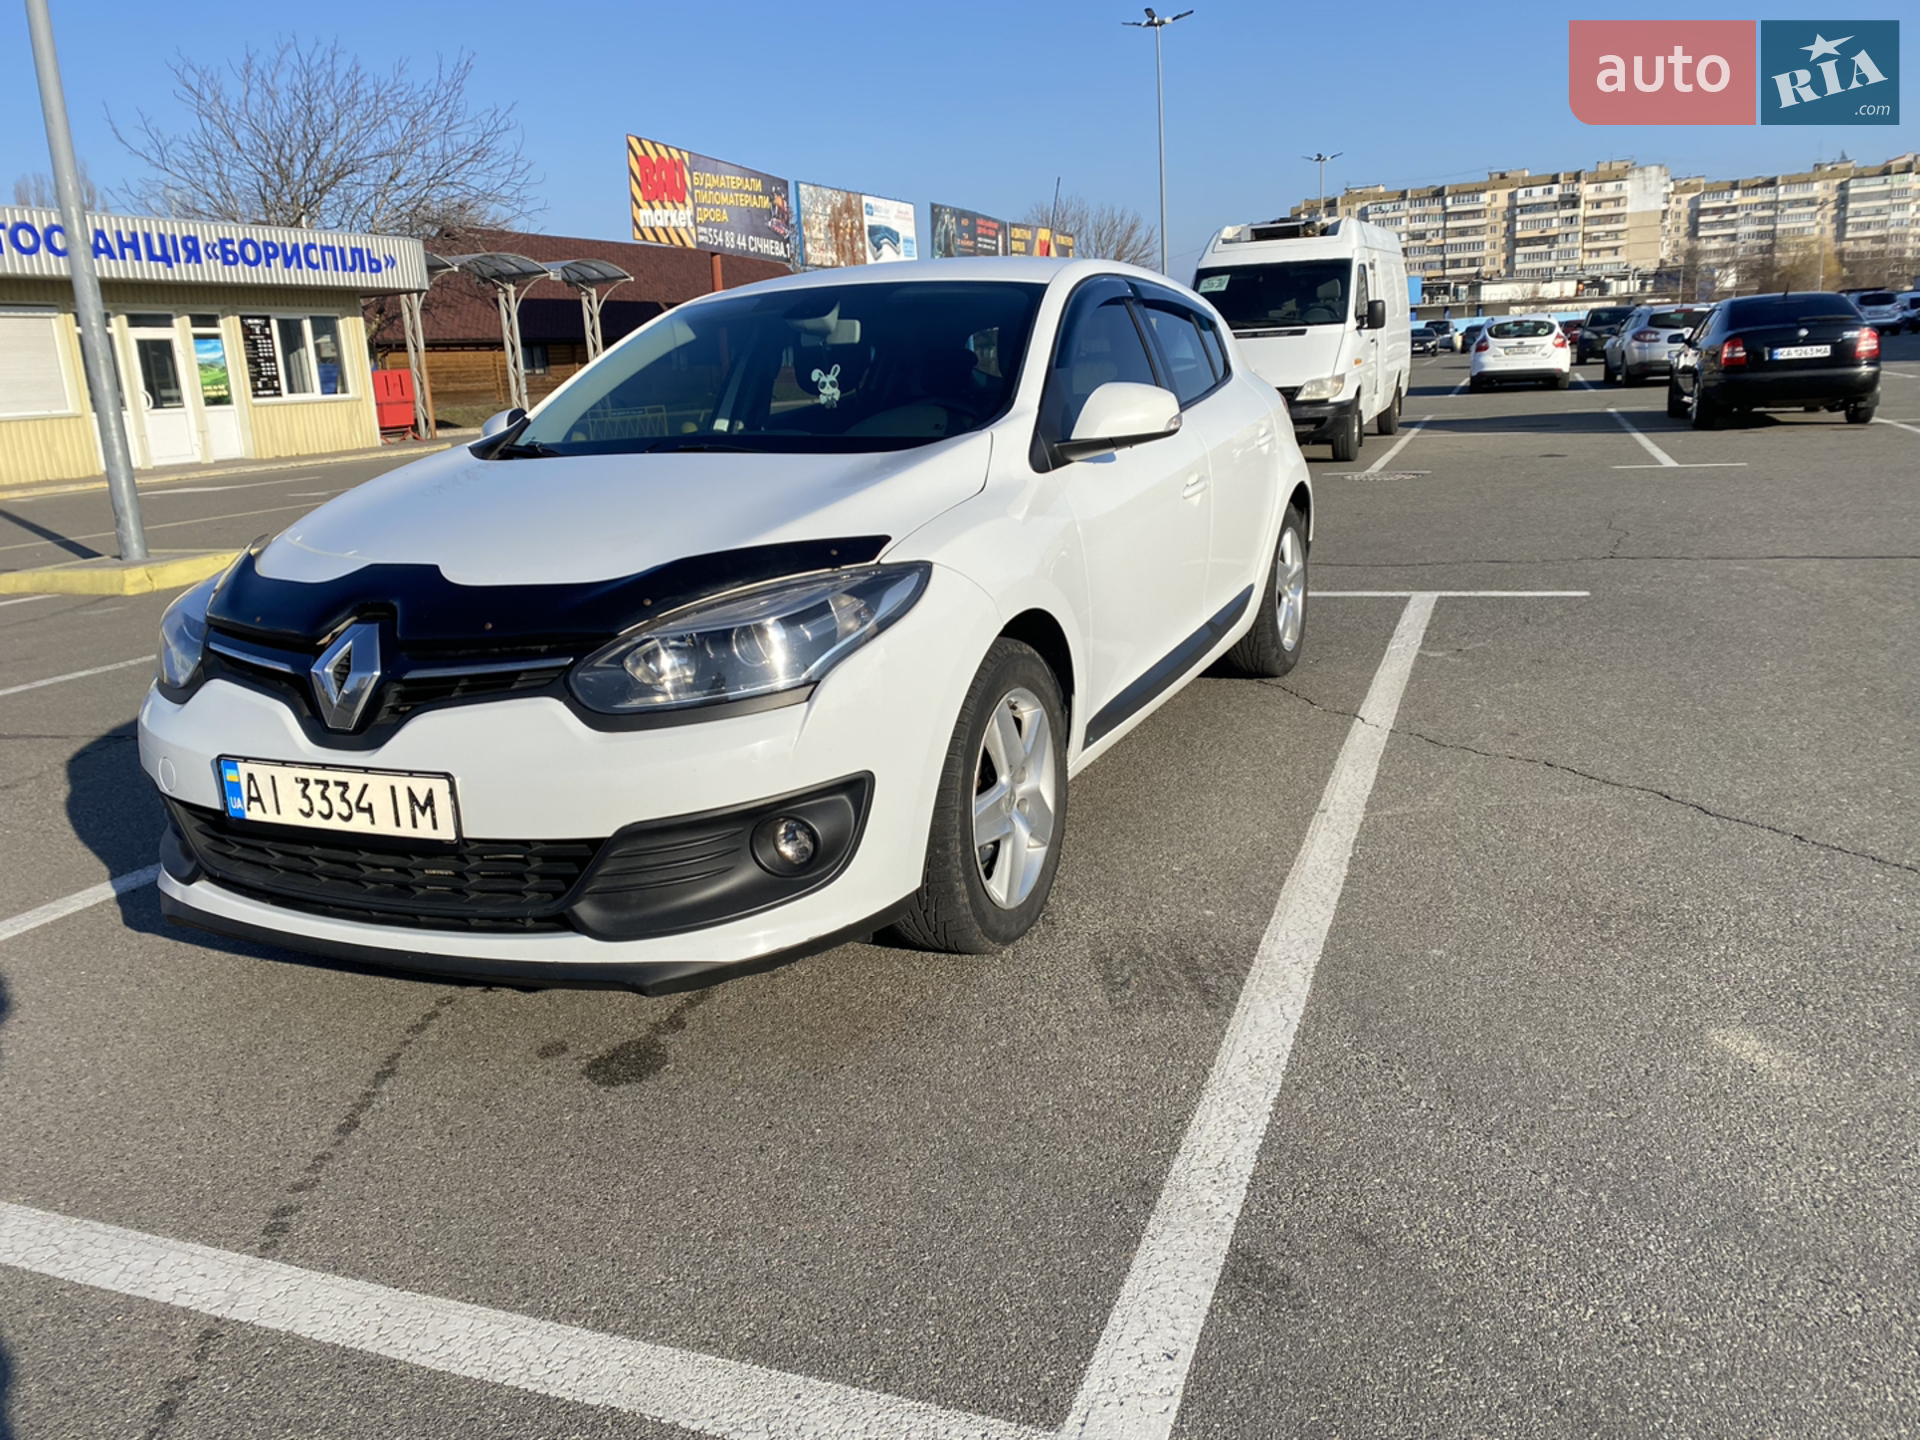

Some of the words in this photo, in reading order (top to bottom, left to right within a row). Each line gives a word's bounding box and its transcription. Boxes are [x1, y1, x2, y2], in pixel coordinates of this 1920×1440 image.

[637, 155, 687, 204] BAU
[693, 171, 762, 192] БУДМАТЕРІАЛИ
[639, 206, 695, 228] market
[696, 207, 729, 224] ДРОВА
[736, 233, 747, 251] 44
[230, 797, 244, 811] UA
[295, 776, 376, 826] 3334
[390, 784, 439, 831] IM
